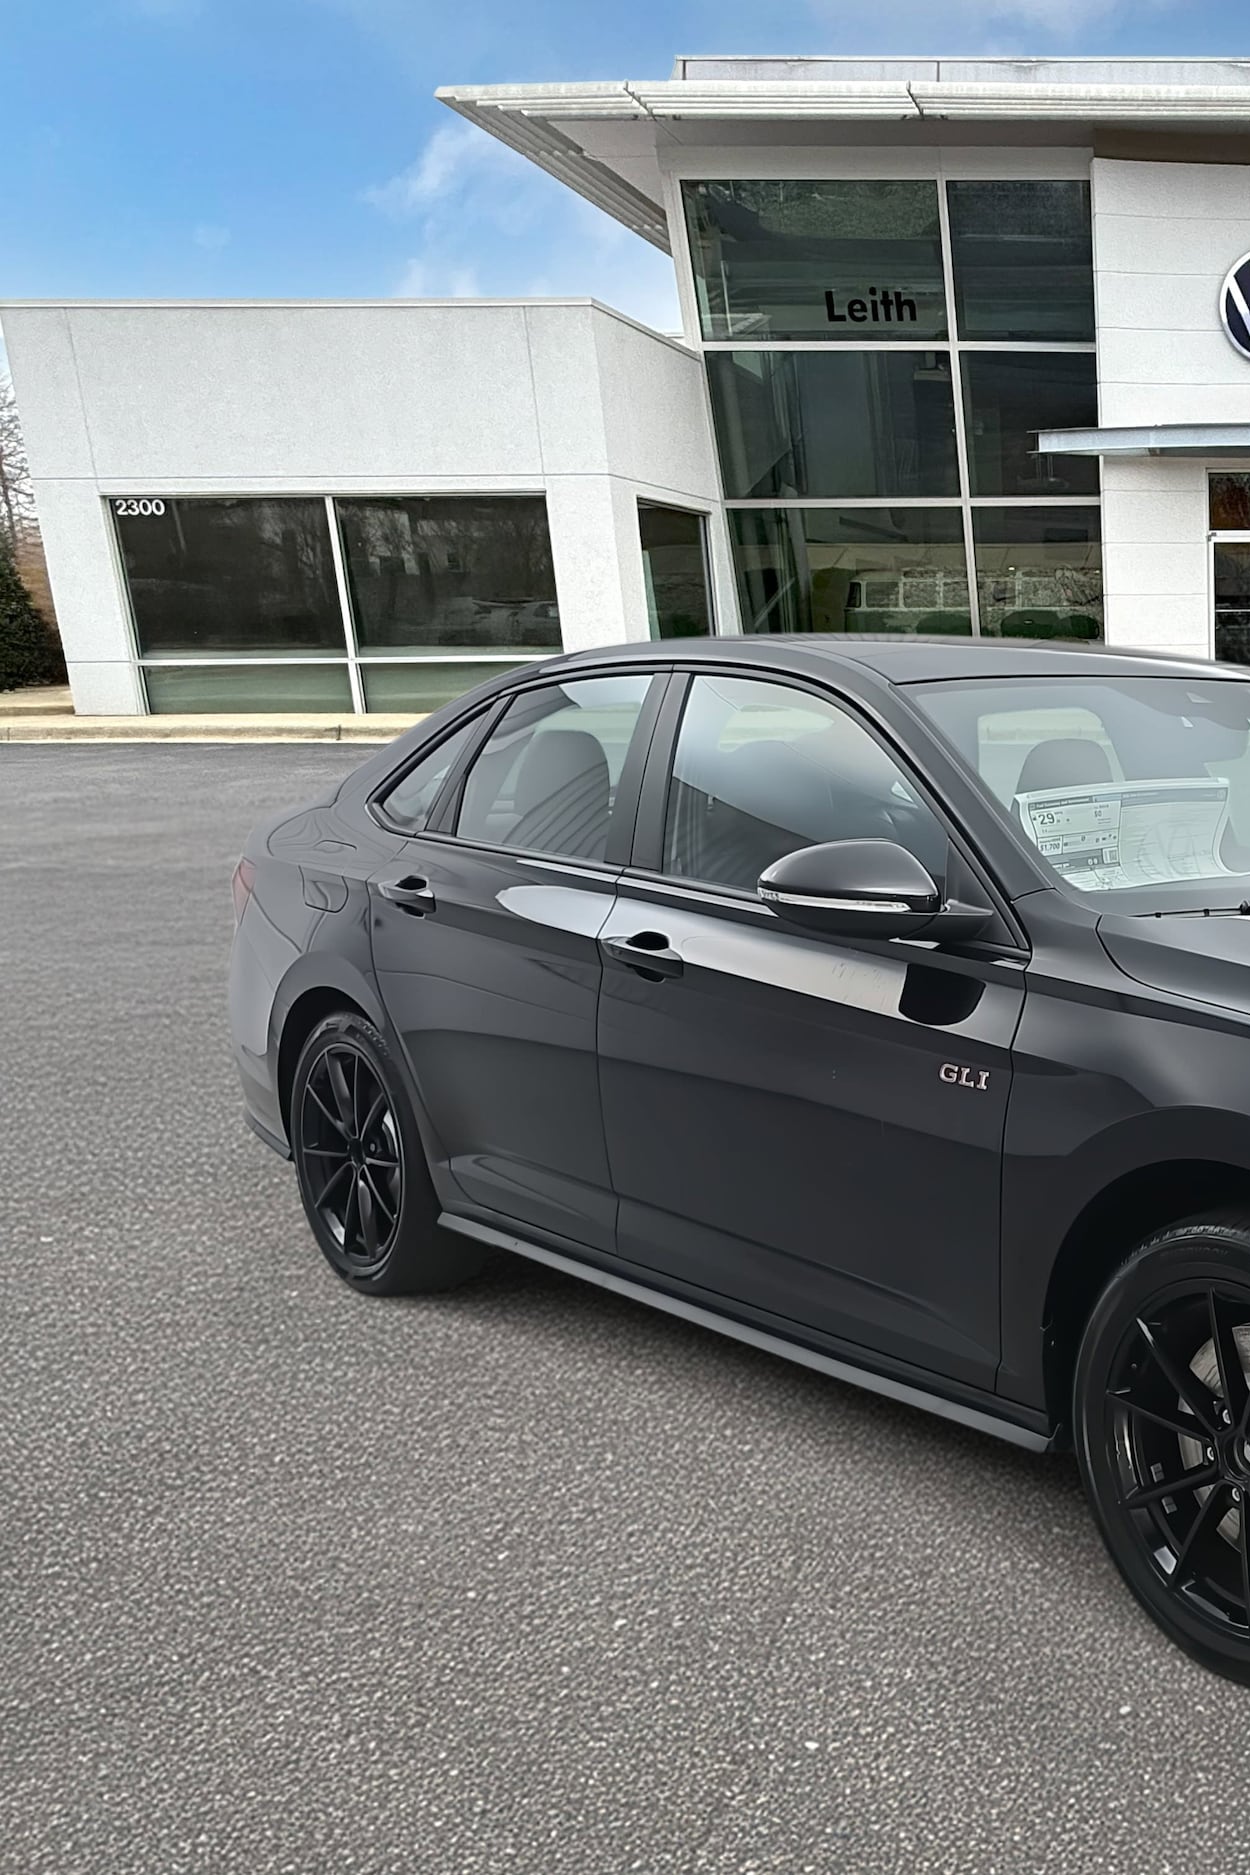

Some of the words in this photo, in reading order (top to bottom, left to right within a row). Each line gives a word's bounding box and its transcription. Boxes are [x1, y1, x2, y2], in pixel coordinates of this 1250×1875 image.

[824, 286, 917, 322] Leith
[115, 499, 165, 516] 2300
[1038, 812, 1055, 825] 29
[939, 1063, 990, 1090] GLI
